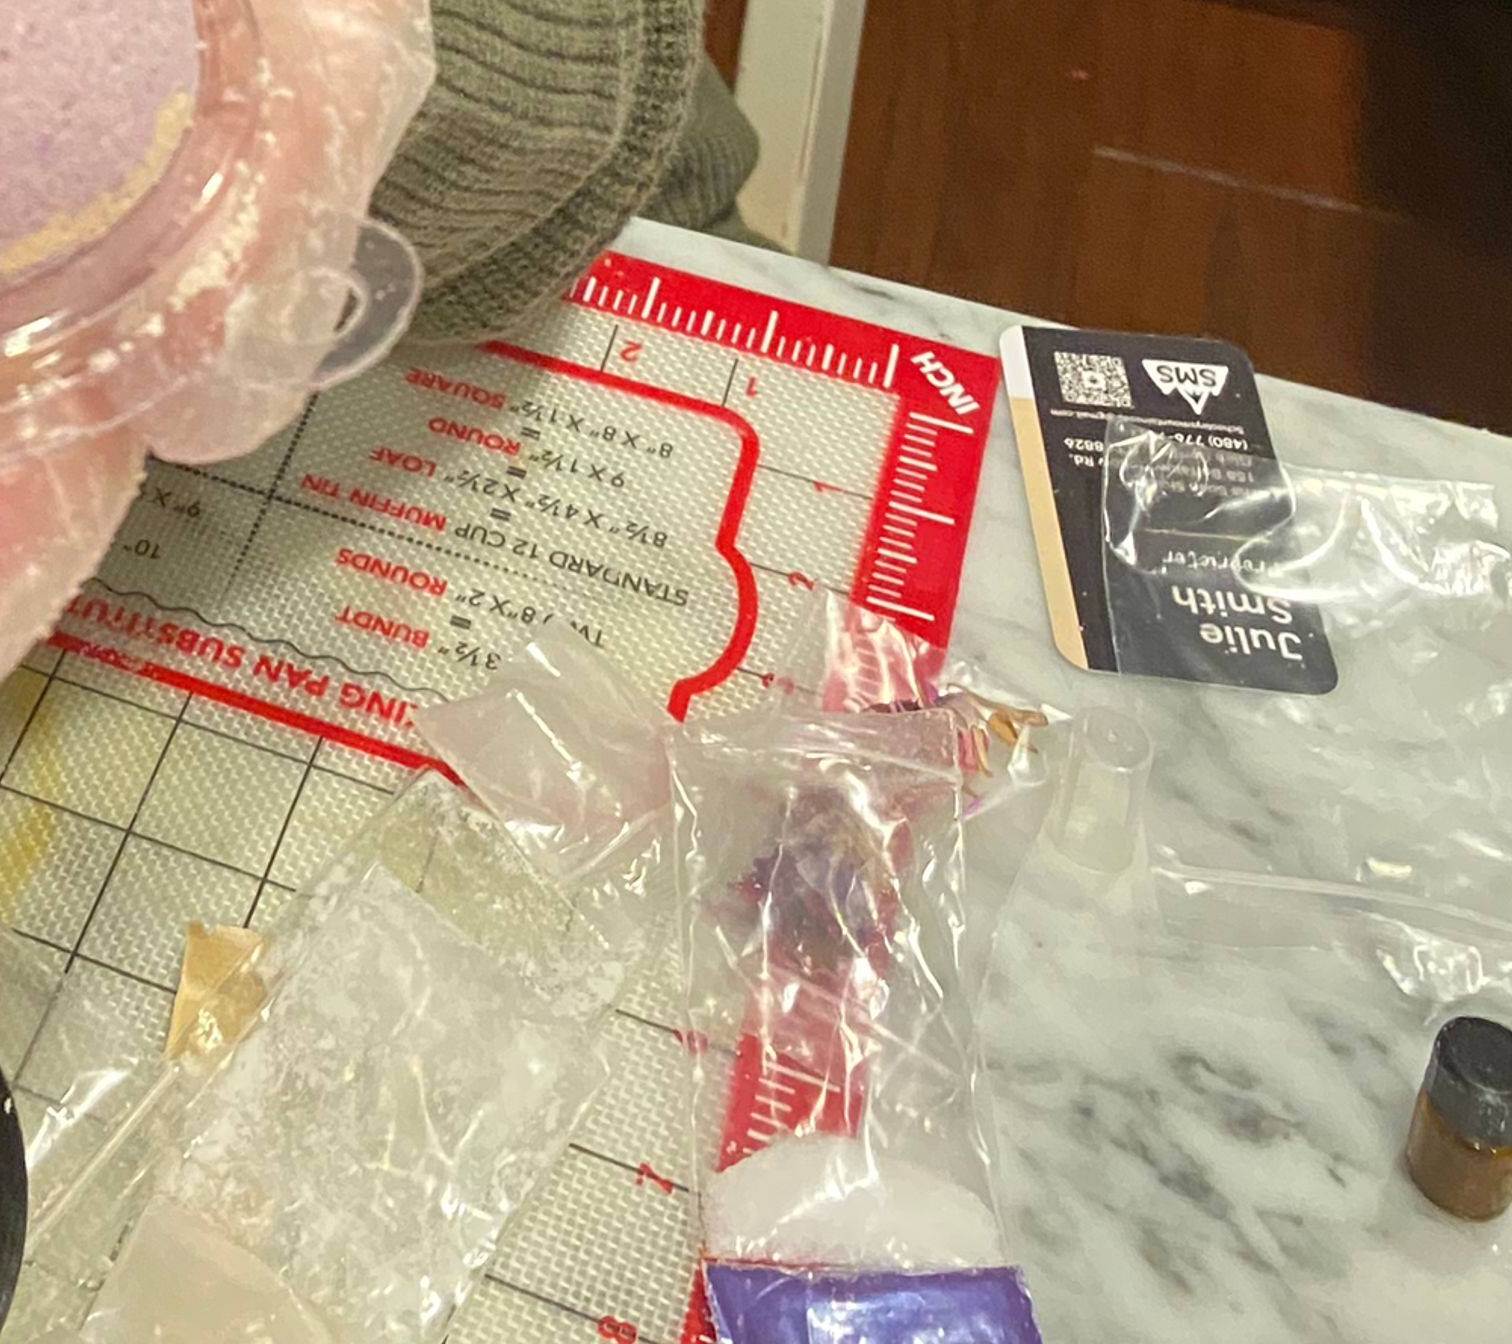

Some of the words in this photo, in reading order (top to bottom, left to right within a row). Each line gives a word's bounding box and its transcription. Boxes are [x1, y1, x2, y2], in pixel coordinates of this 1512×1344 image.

[620, 342, 644, 362] 2
[405, 368, 507, 410] SQUARE
[745, 377, 758, 398] 1
[910, 351, 981, 415] INCH
[1156, 365, 1216, 387] SMS
[427, 416, 521, 457] ROUND
[564, 414, 585, 433] X
[620, 430, 641, 449] X
[1207, 435, 1248, 451] (480)
[369, 446, 437, 478] LOAF
[587, 464, 607, 482] X
[1068, 453, 1095, 467] Rd.
[300, 473, 340, 499] TIN
[612, 472, 625, 488] 9
[348, 488, 447, 532] MUFFIN
[454, 523, 506, 548] CUP
[511, 538, 540, 560] 12
[335, 546, 448, 597] ROUNDS
[1171, 585, 1294, 624] Smith
[63, 595, 245, 668] SUBSTITUT
[335, 606, 429, 648] BUNDT
[1199, 623, 1303, 661] Julie
[253, 654, 330, 697] PAN
[598, 1317, 637, 1343] 8
